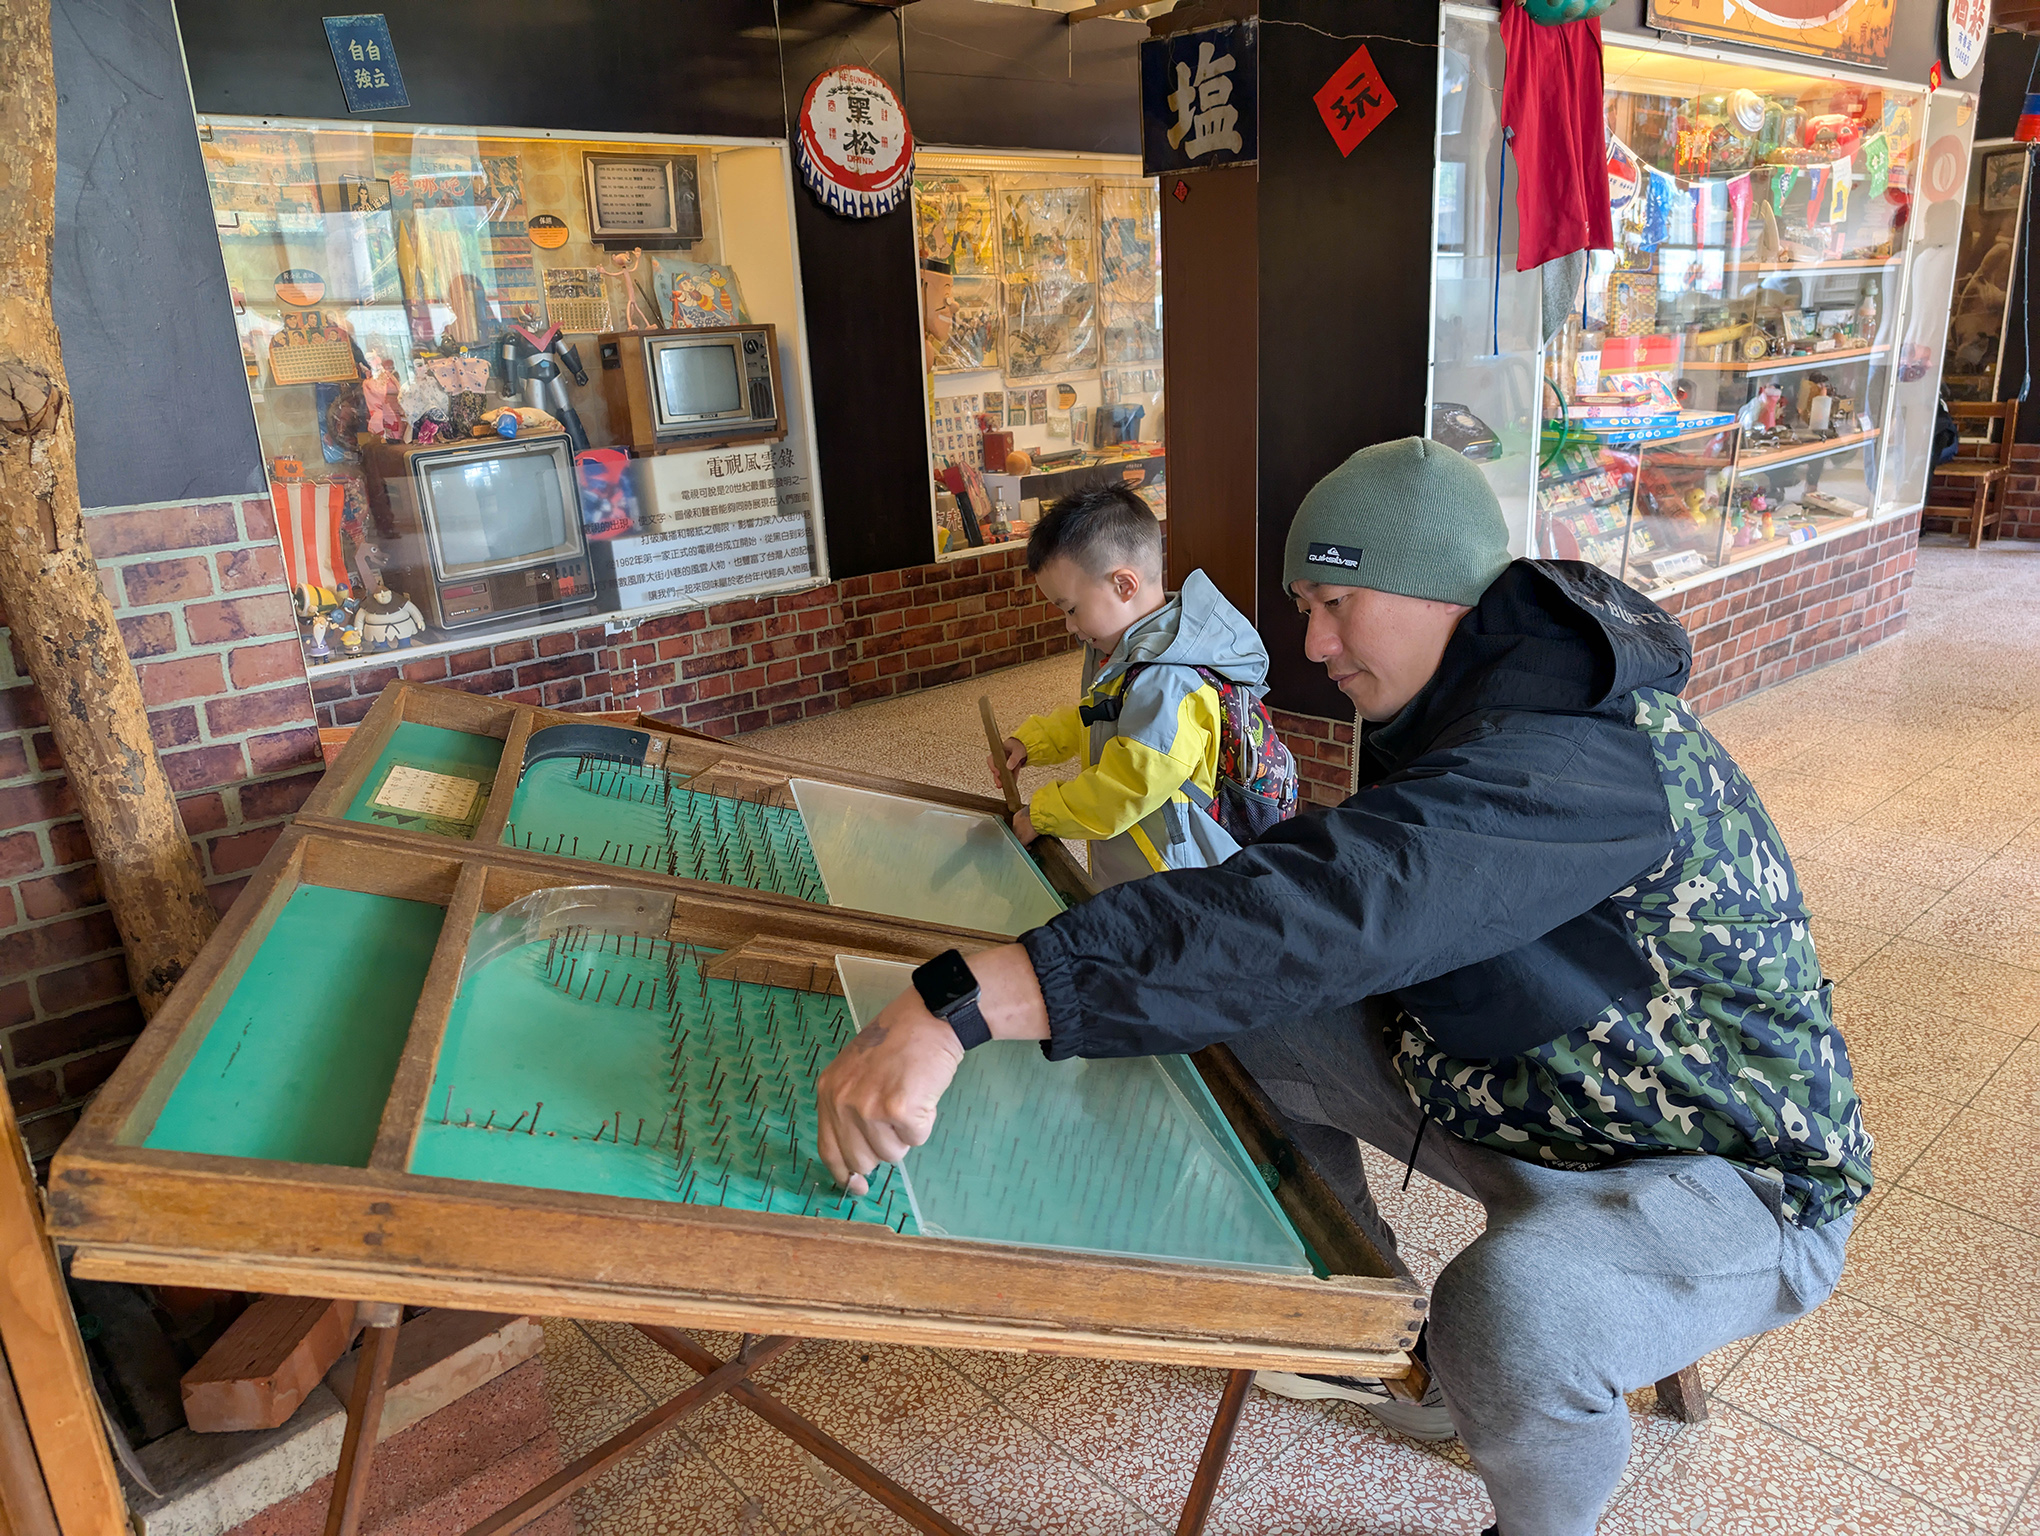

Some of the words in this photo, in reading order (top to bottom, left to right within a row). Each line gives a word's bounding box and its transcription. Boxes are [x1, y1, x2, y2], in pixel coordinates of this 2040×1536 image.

[843, 96, 881, 156] 黑松
[1167, 41, 1243, 160] 塩
[1330, 73, 1382, 131] 玩
[846, 154, 874, 166] DRINK
[707, 448, 795, 478] 電視風雲錄
